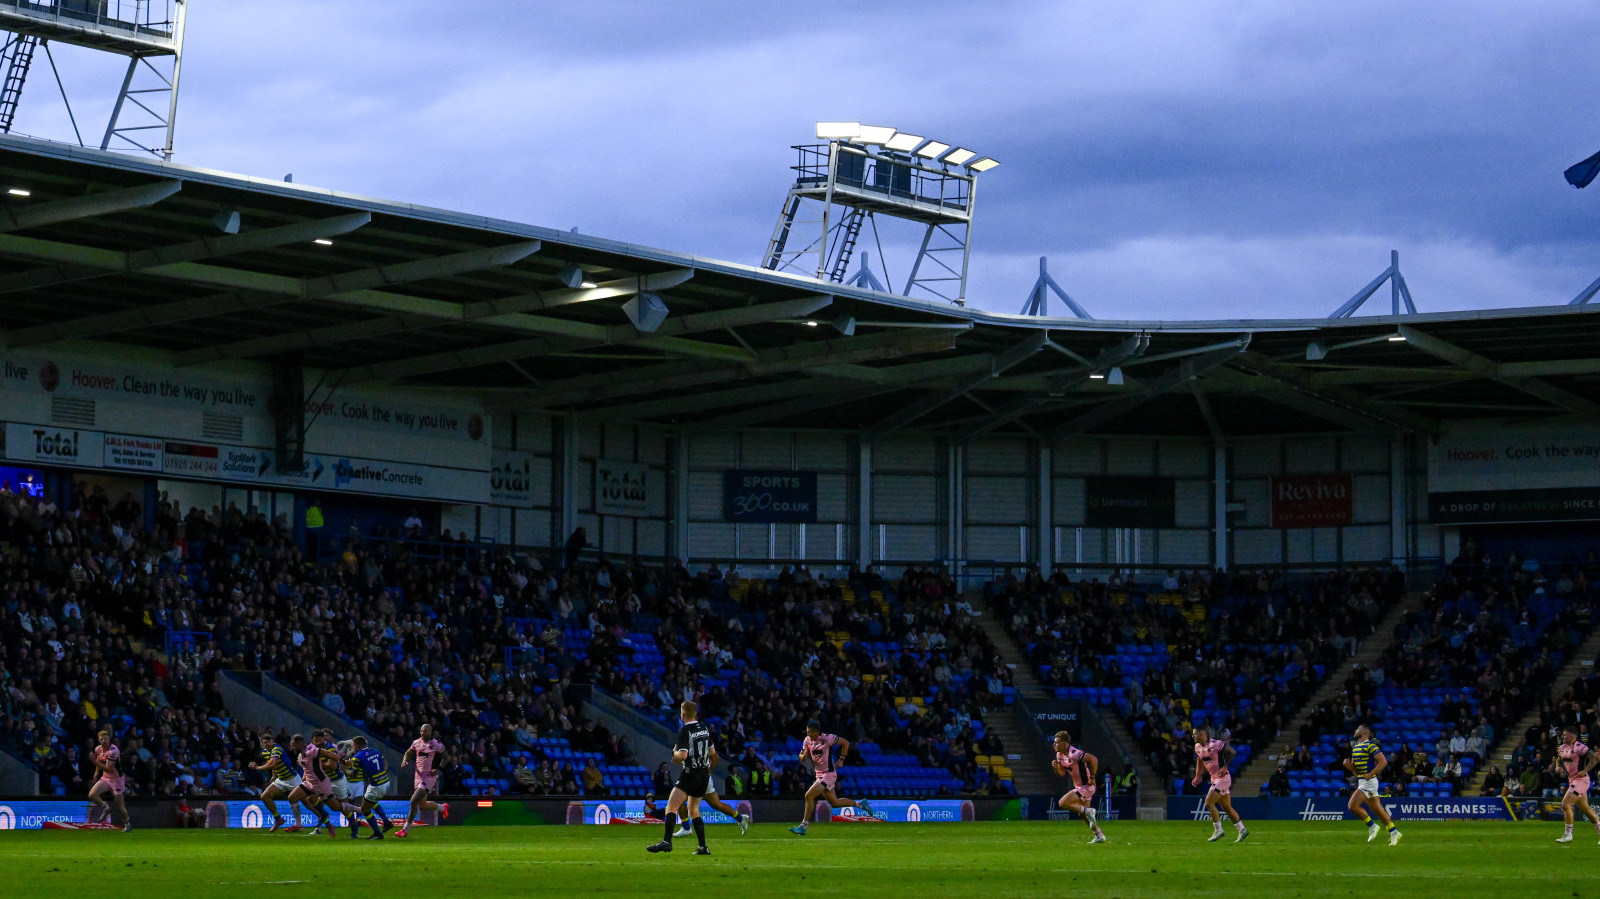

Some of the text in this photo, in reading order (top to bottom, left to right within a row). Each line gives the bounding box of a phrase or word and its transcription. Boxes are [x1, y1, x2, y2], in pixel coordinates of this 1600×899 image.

[5, 360, 28, 380] live
[123, 375, 156, 395] Clean
[160, 380, 180, 397] the
[184, 386, 207, 405] way
[212, 389, 233, 406] you
[235, 388, 256, 407] live
[342, 402, 369, 420] Cook
[372, 406, 391, 423] the
[394, 411, 415, 430] way
[419, 414, 437, 430] you
[439, 414, 458, 431] live
[33, 429, 78, 457] Total
[1505, 445, 1540, 459] Cook
[1545, 443, 1570, 458] the
[1573, 445, 1600, 459] way
[164, 456, 217, 472] 01925 244 244
[228, 452, 256, 464] TopMark
[222, 462, 256, 473] Solutions
[491, 459, 530, 491] otal
[600, 468, 646, 501] Total
[742, 475, 801, 488] SPORTS
[1279, 479, 1347, 501] Reviva
[1439, 503, 1447, 513] A
[1450, 502, 1479, 513] DROP
[1483, 501, 1497, 512] OF
[1562, 499, 1596, 509] SINCE
[372, 758, 380, 770] 7
[923, 810, 954, 820] NORTHERN
[1400, 804, 1486, 814] WIRE CRANES
